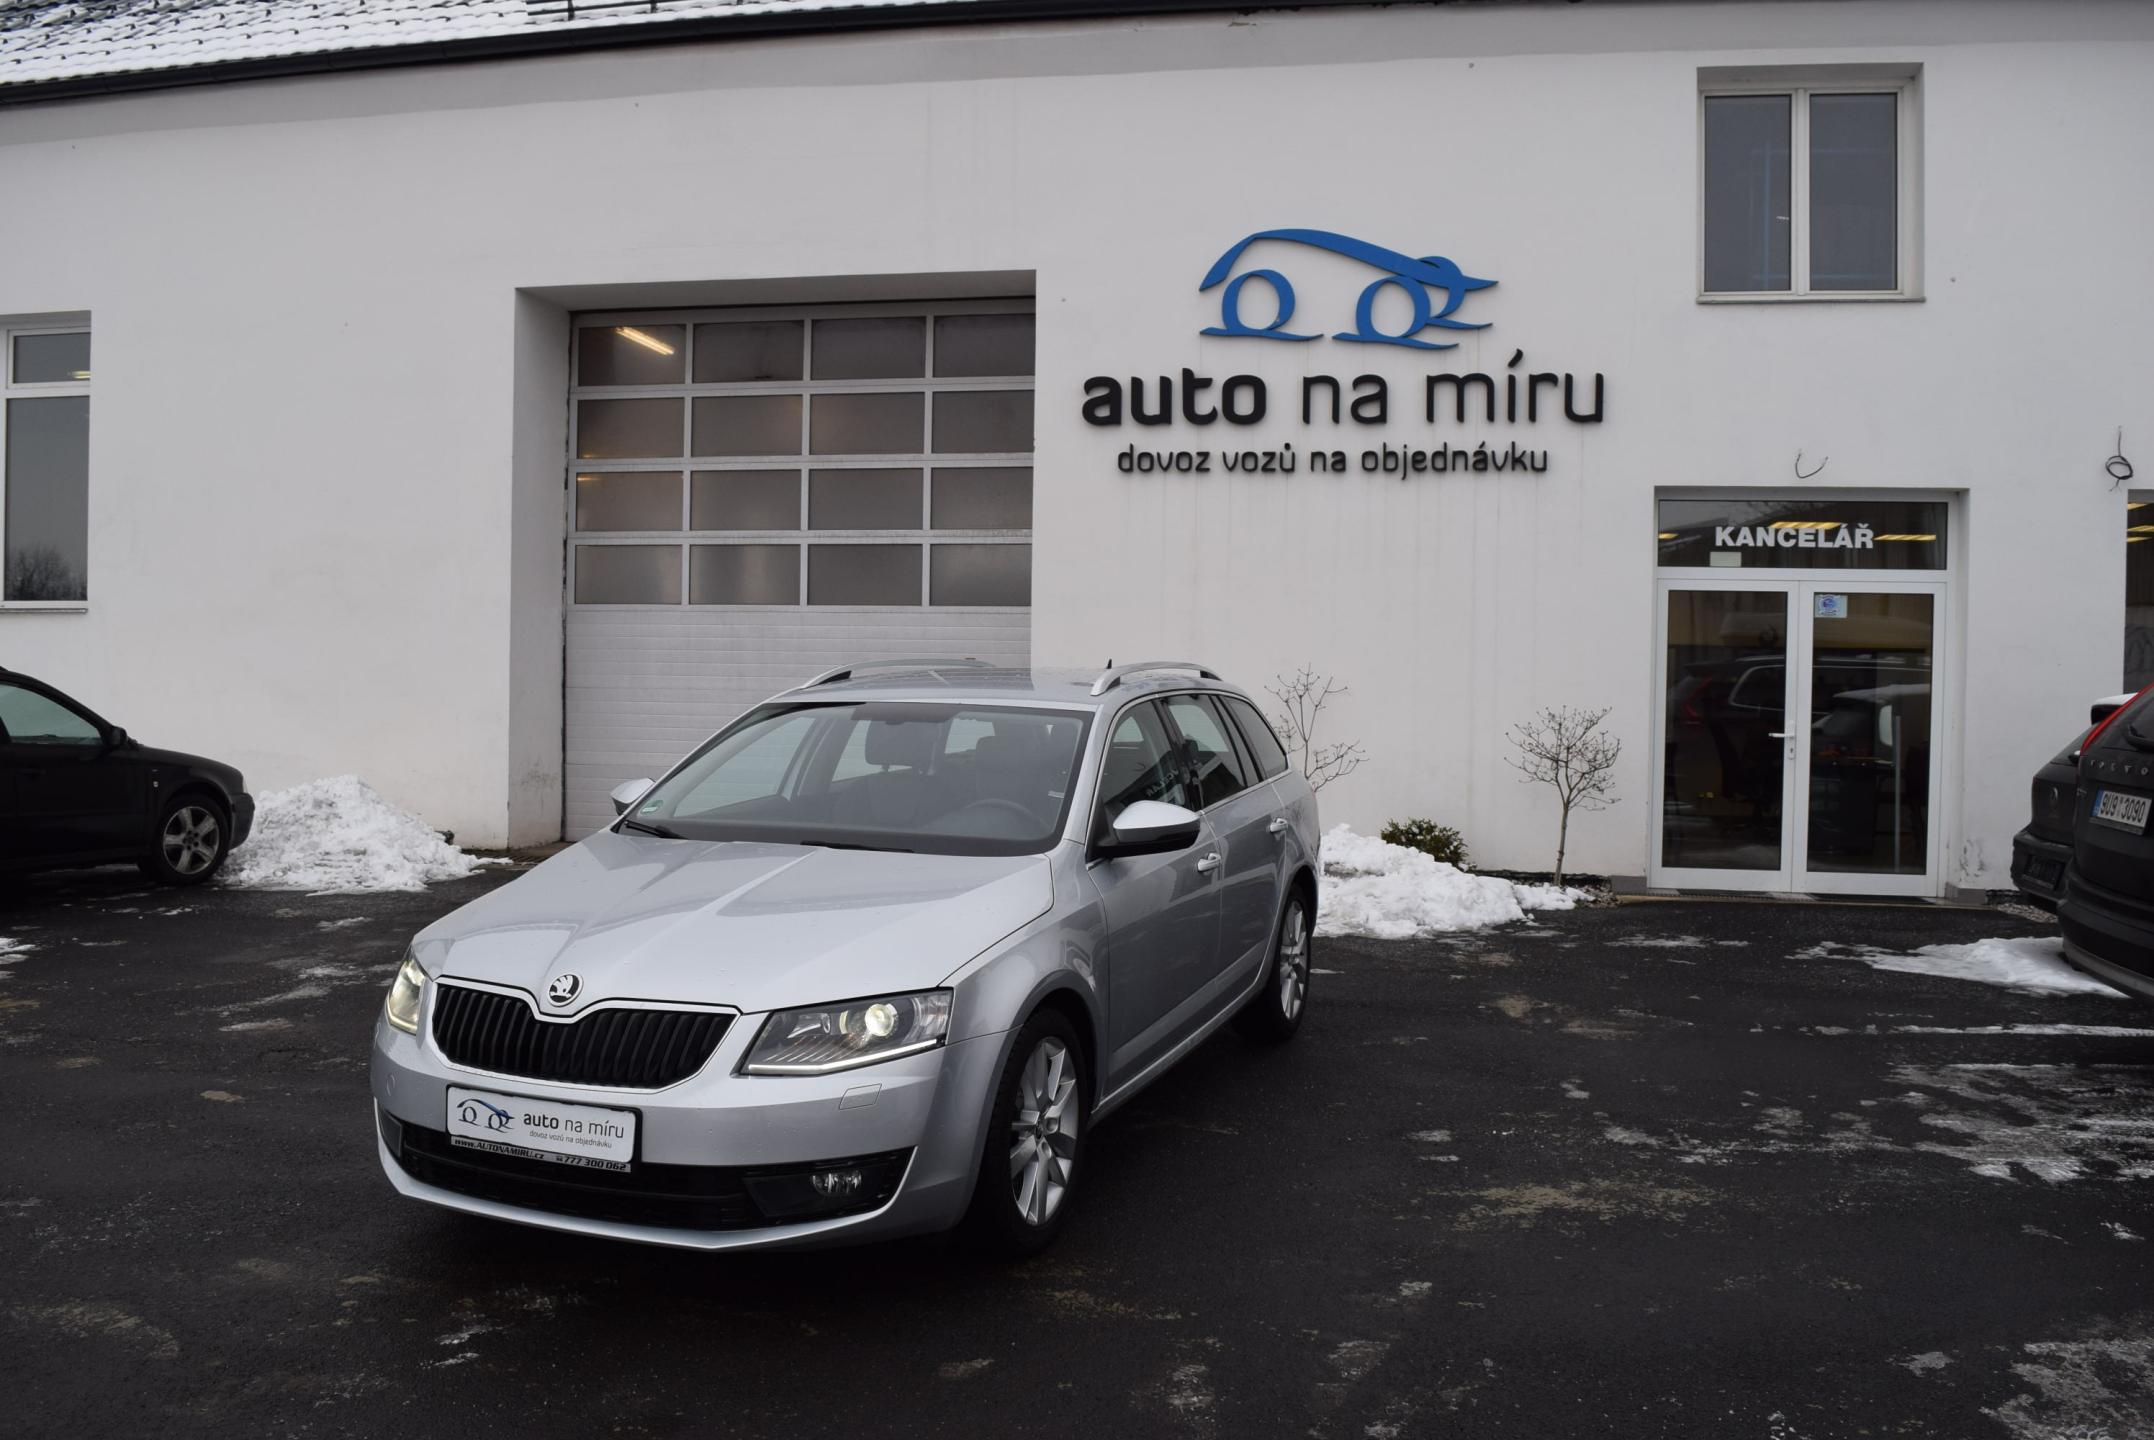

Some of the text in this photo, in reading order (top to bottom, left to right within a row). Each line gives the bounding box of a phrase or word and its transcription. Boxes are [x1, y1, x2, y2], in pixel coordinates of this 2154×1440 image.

[1082, 348, 1605, 427] auto na míru
[1117, 440, 1548, 480] dovoz vozů na objednávku
[1715, 523, 1874, 549] KANCELÁŘ
[2100, 792, 2147, 823] 9U9 3090
[523, 1113, 625, 1139] auto na míru
[565, 1135, 574, 1143] na
[564, 1155, 583, 1165] 777
[583, 1158, 604, 1169] 300
